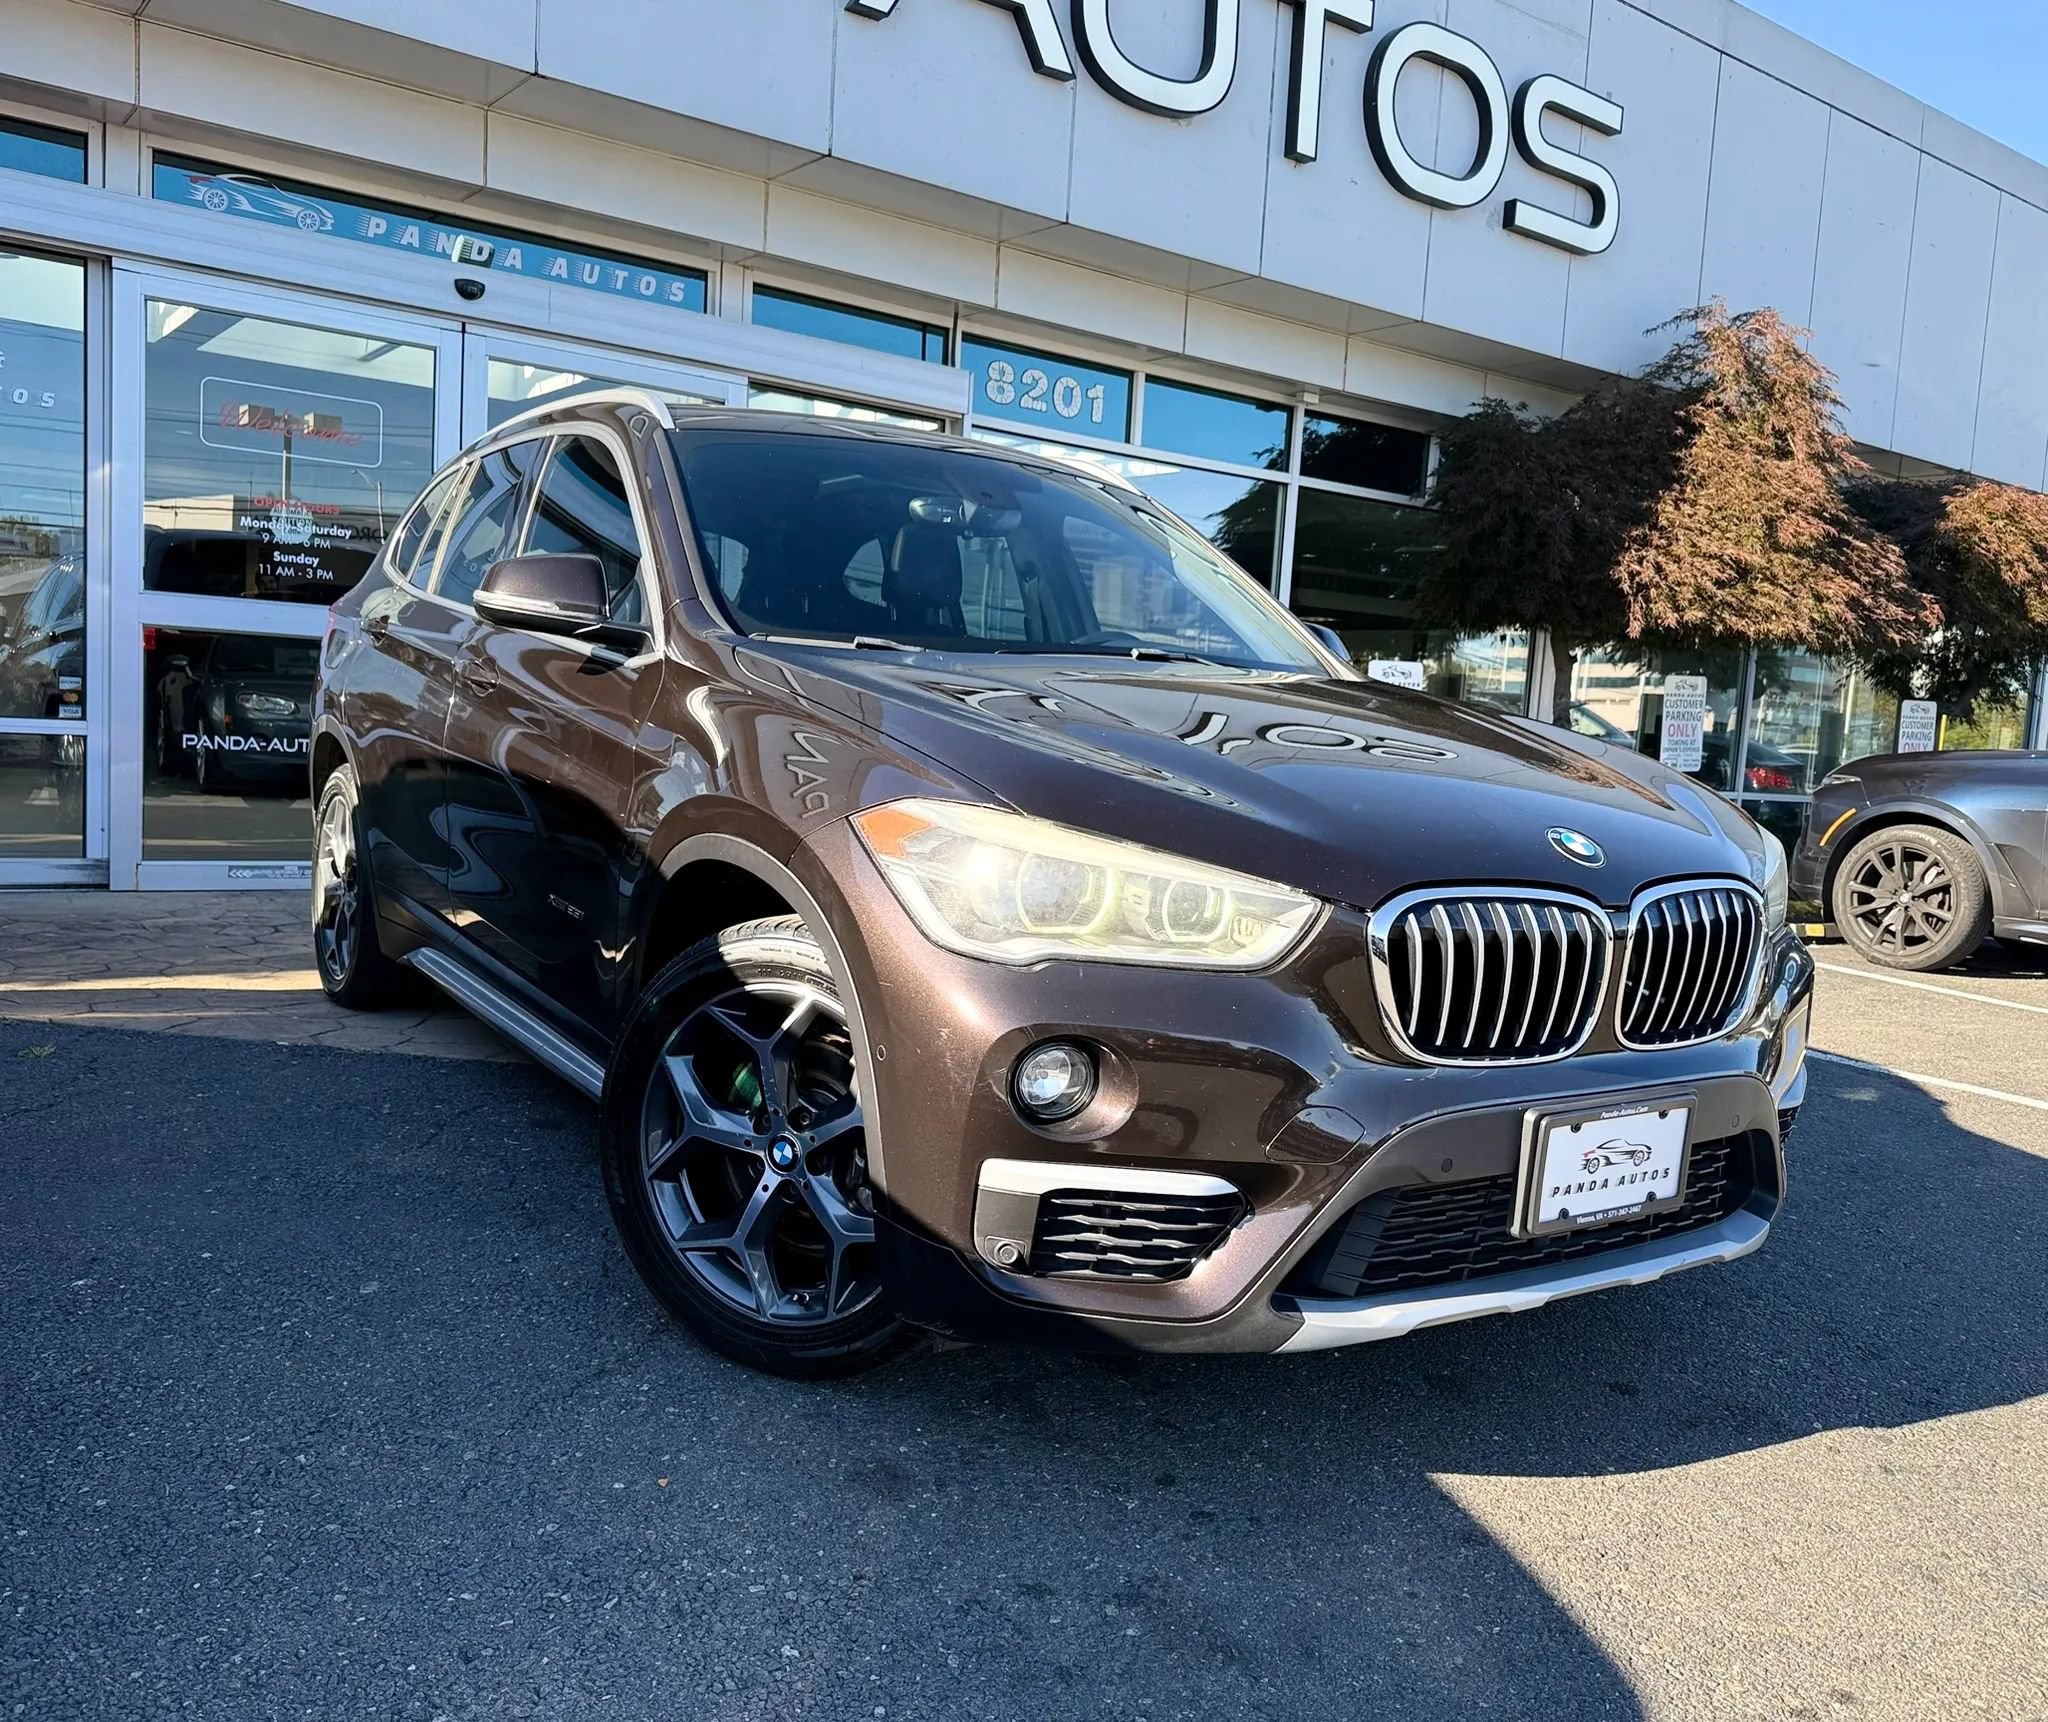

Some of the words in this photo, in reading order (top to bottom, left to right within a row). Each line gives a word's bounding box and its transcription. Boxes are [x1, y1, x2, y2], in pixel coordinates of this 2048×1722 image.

[845, 0, 1624, 255] UTOS
[366, 216, 522, 270] PANDA
[550, 256, 685, 302] AUTOS
[0, 386, 55, 408] OS
[985, 361, 1104, 423] 8201
[262, 532, 270, 543] 9
[314, 538, 331, 549] PM
[273, 551, 320, 568] Sunday
[259, 564, 271, 575] 11
[276, 566, 295, 578] AM
[306, 568, 313, 579] 3
[317, 569, 334, 581] PM
[1665, 698, 1704, 709] CUSTOMER
[1666, 710, 1702, 722] PARKING
[1668, 723, 1698, 738] ONLY
[1902, 720, 1934, 730] CUSTOMER
[182, 734, 310, 753] PANDA-AUT
[1901, 731, 1932, 741] PARKING
[1552, 1178, 1609, 1198] PANDA
[1618, 1167, 1670, 1186] AUTOS
